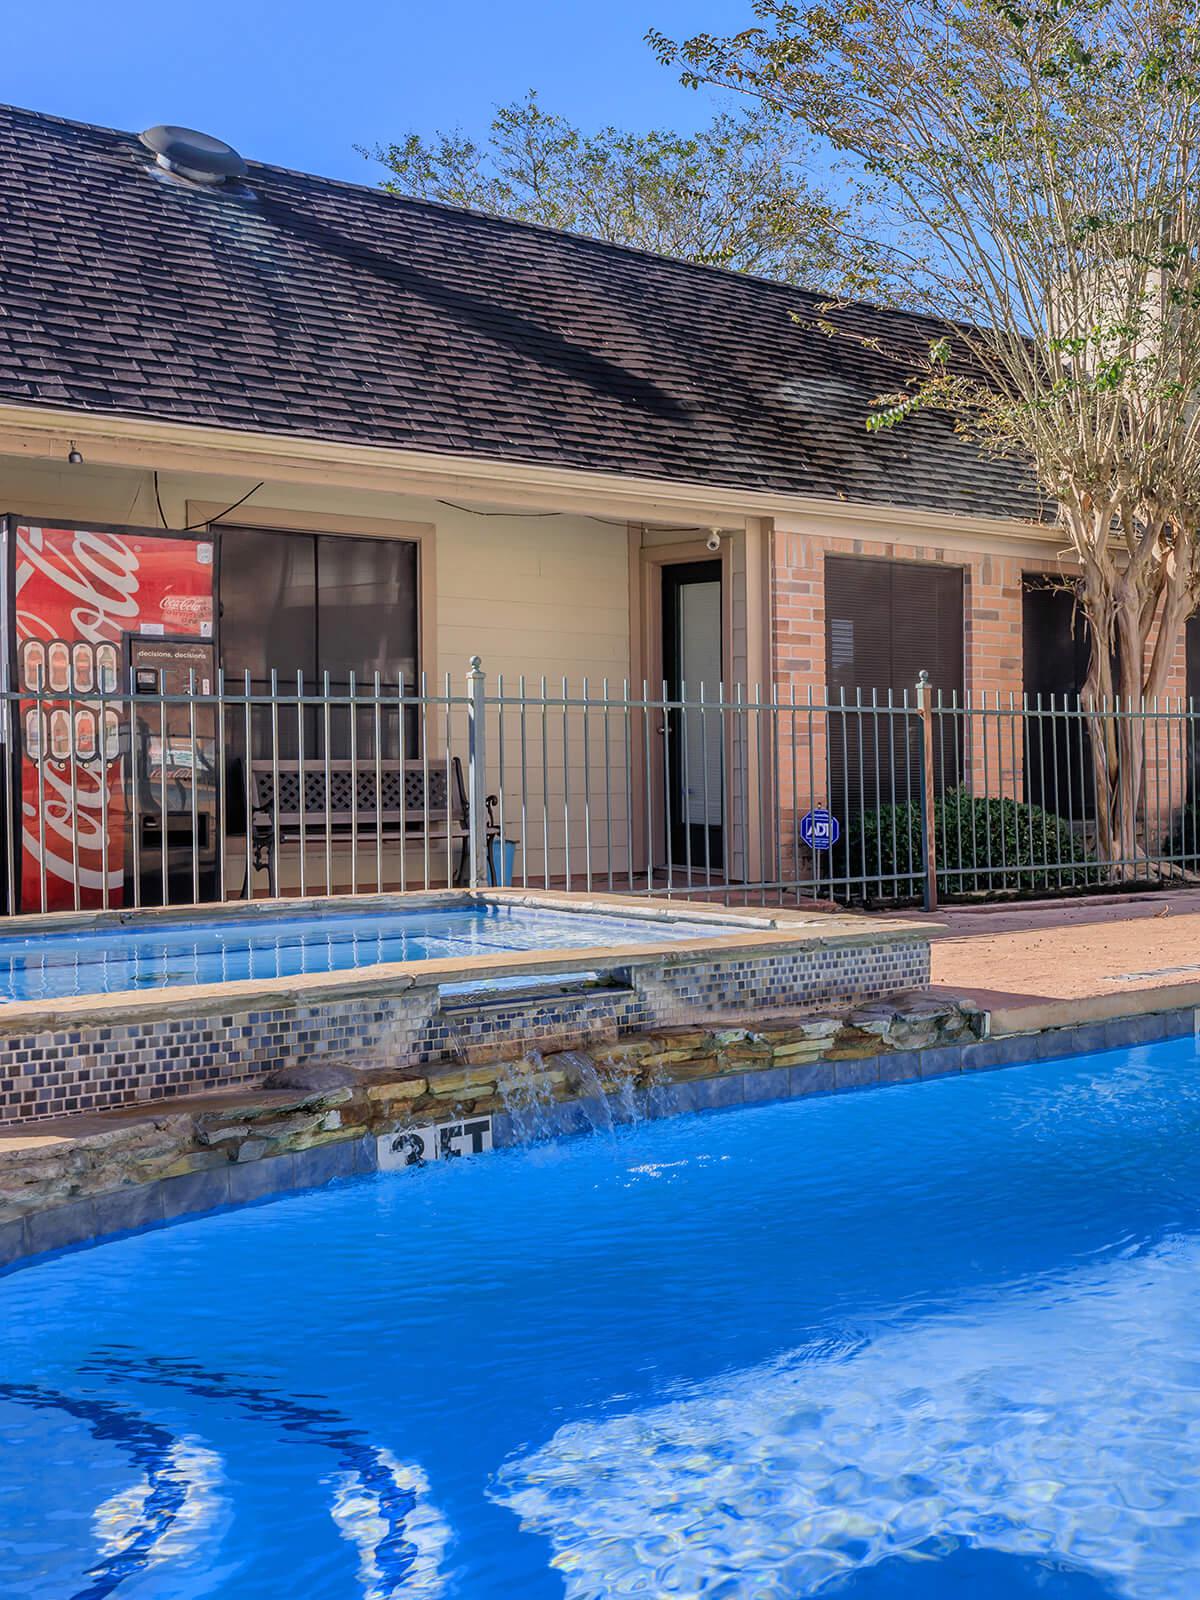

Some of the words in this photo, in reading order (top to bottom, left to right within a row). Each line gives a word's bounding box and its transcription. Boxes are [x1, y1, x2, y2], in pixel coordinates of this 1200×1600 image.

[138, 650, 173, 659] decisions,
[174, 651, 207, 660] decisions
[806, 822, 832, 837] ADT
[440, 1119, 491, 1158] FT
